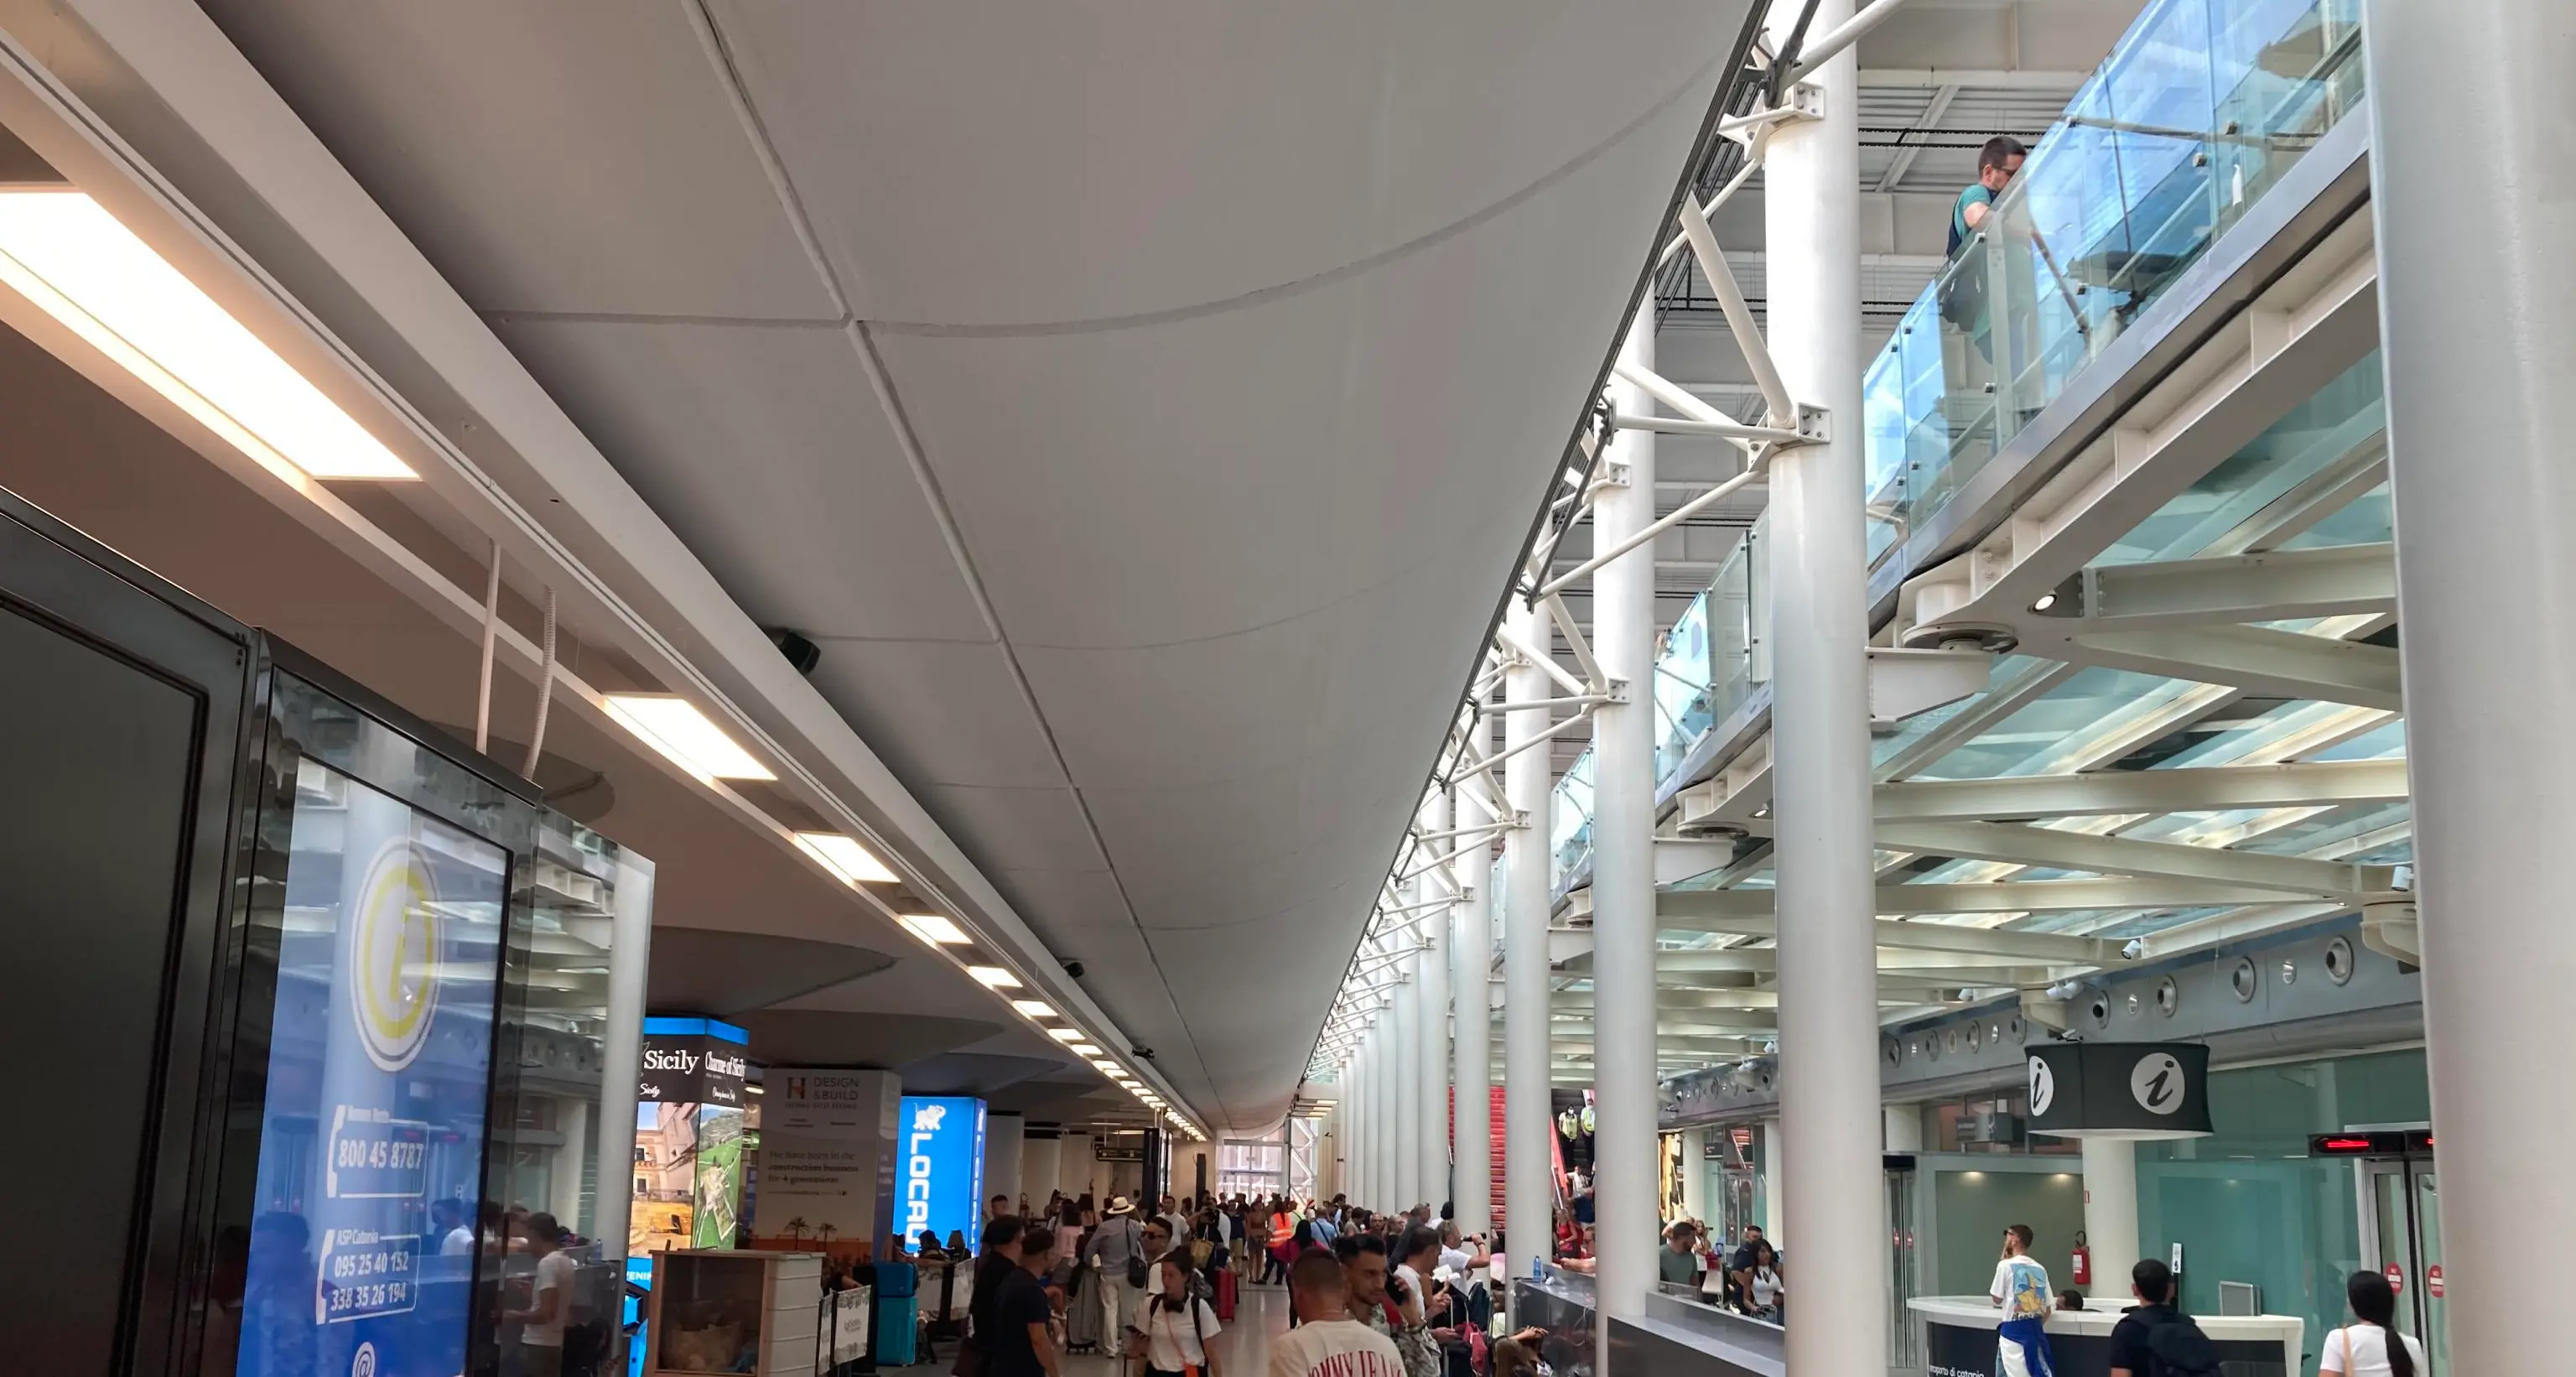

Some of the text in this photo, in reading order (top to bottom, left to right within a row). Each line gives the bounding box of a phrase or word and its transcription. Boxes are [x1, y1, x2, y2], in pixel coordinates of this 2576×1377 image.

[643, 1049, 699, 1074] Sicily
[813, 1077, 860, 1088] DESIGN
[813, 1090, 859, 1100] &BUILD
[338, 1139, 424, 1170] 800 45 8787
[906, 1132, 933, 1257] LOCAU
[335, 1250, 409, 1278] 095 25 40 152
[330, 1281, 407, 1312] 338 35 26 194
